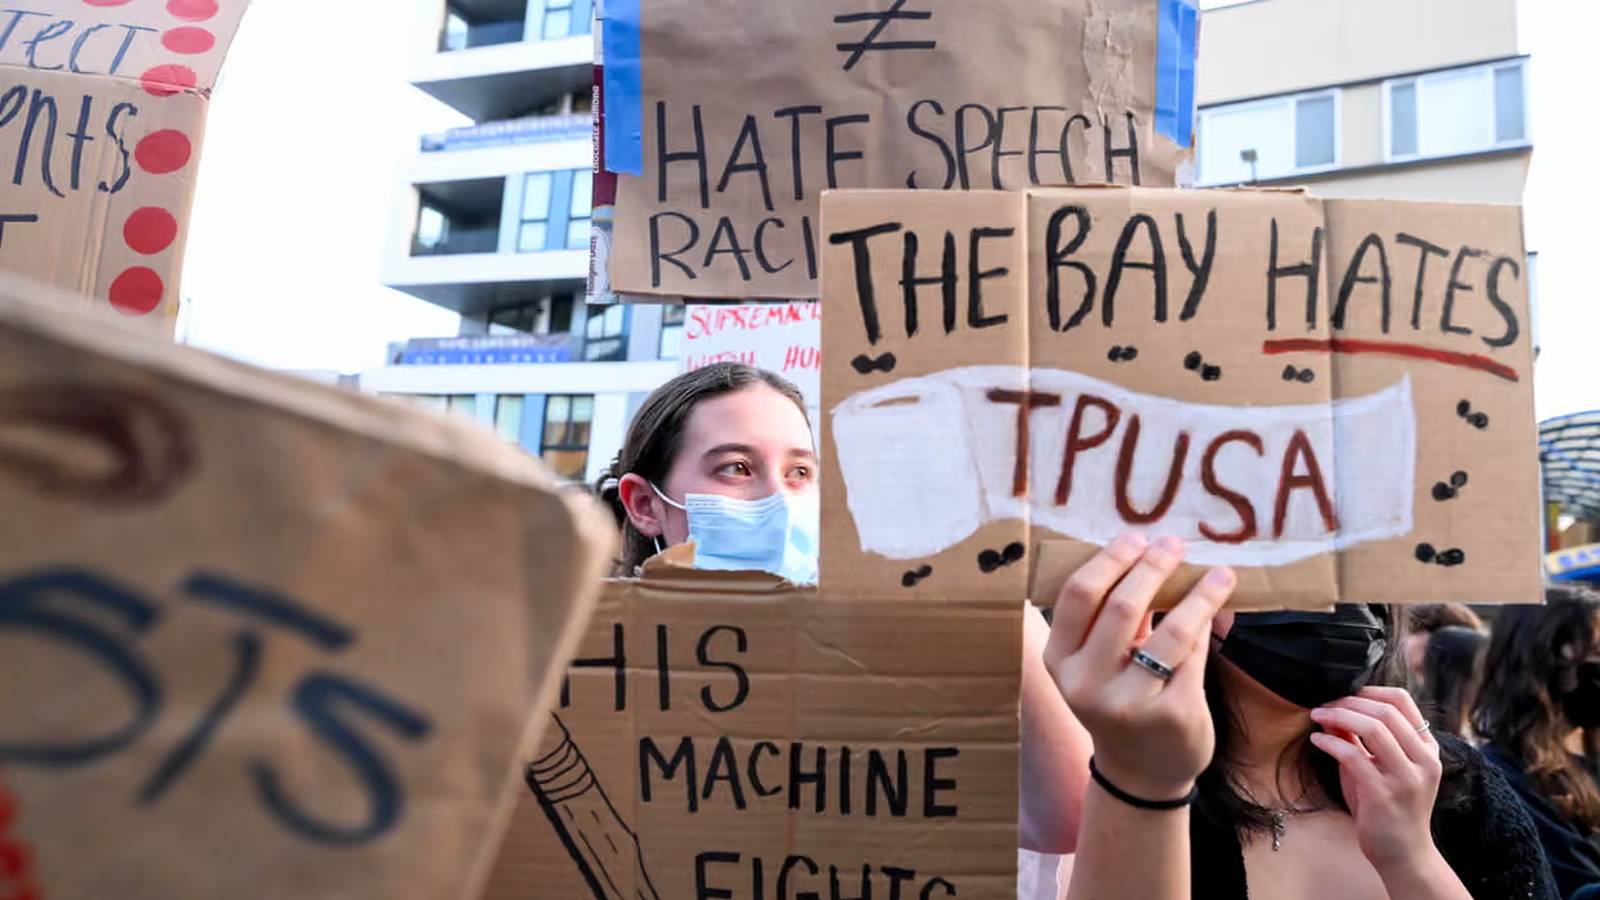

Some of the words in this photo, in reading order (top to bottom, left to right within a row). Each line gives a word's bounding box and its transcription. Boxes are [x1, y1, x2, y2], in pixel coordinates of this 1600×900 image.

[656, 100, 870, 211] HATE
[906, 99, 1140, 189] SPEECH
[829, 221, 1014, 345] THE
[1046, 205, 1217, 332] BAY
[1265, 217, 1521, 348] HATES
[986, 389, 1338, 544] TPUSA
[638, 735, 961, 819] MACHINE
